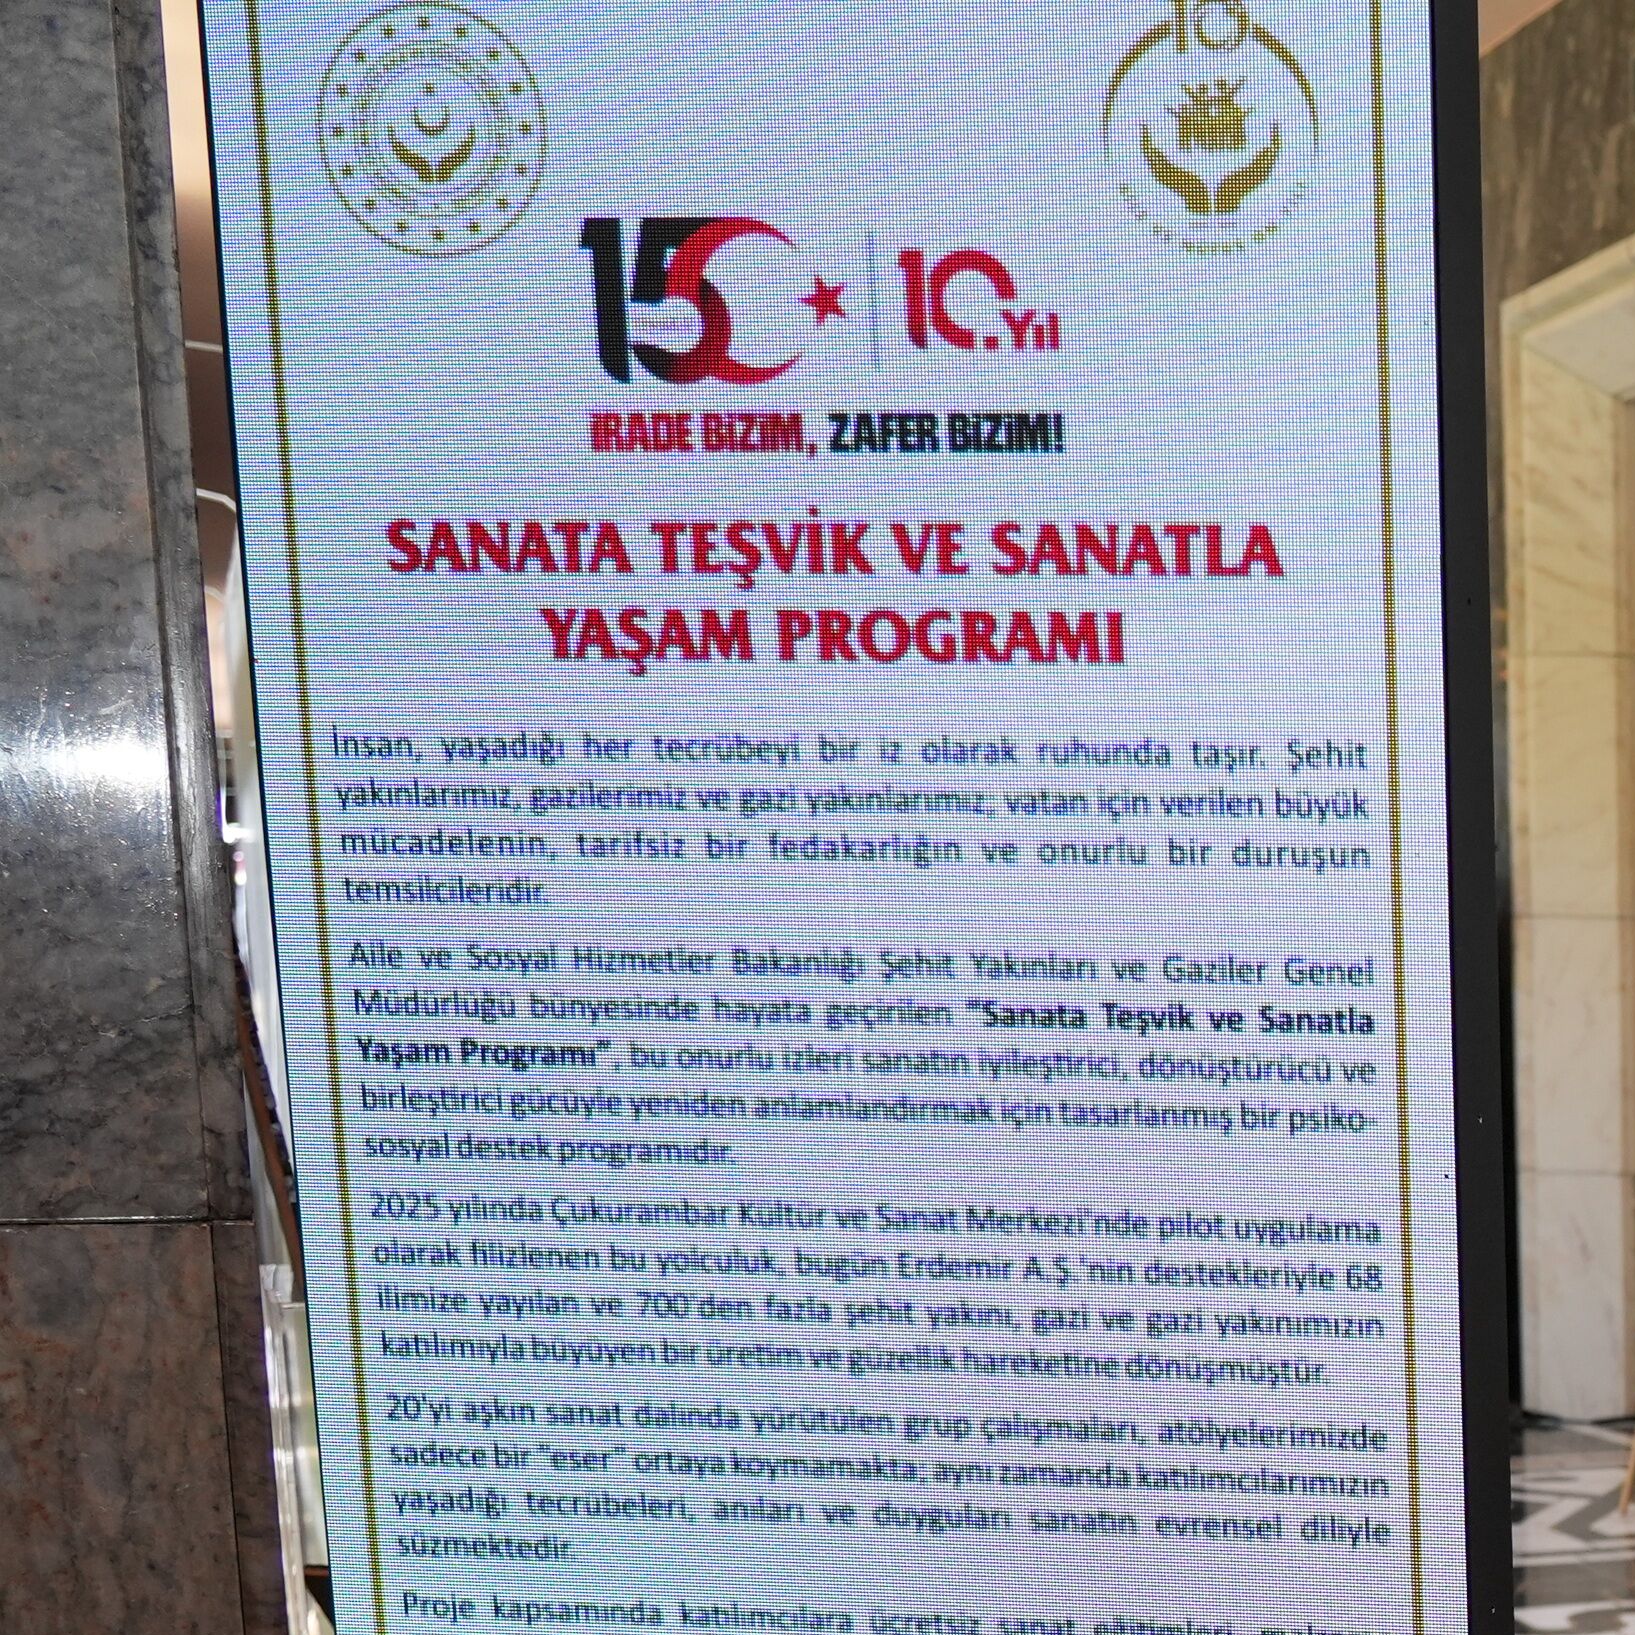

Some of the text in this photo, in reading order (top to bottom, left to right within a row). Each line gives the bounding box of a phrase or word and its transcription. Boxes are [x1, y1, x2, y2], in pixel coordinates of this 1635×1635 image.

[589, 411, 1065, 460] İRADE BİZİM, ZAFER BİZİM!
[387, 504, 1284, 590] SANATA TEŞVİK VE SANATLA
[541, 607, 1126, 675] YAŞAM PROGRAMI
[330, 725, 422, 766] İnsan,
[441, 729, 566, 766] yaşadığı
[581, 730, 634, 761] her
[817, 732, 858, 763] bir
[879, 732, 901, 763] iz
[920, 733, 1017, 764] olarak
[1036, 734, 1172, 765] ruhunda
[1189, 741, 1266, 772] taşır.
[1286, 735, 1366, 772] Şehit
[338, 824, 556, 864] mücadelenin,
[574, 828, 685, 859] tarifsiz
[703, 829, 748, 860] bir
[980, 842, 1018, 863] ve
[1037, 834, 1147, 865] onurlu
[1166, 835, 1211, 866] bir
[1231, 835, 1370, 873] duruşun
[352, 986, 515, 1020] Müdürlüğü
[530, 989, 697, 1027] bünyesinde
[713, 992, 811, 1030] hayata
[1102, 999, 1194, 1036] Teşvik
[1207, 1010, 1245, 1032] ve
[1258, 1001, 1375, 1034] Sanatla
[356, 1034, 452, 1072] Yaşam
[630, 1039, 667, 1071] bu
[676, 1041, 773, 1073] onurlu
[783, 1042, 852, 1074] izleri
[863, 1051, 969, 1076] sanatın
[1137, 1049, 1332, 1087] dönüştürücü
[1342, 1063, 1375, 1084] ve
[370, 1189, 441, 1221] 2025
[448, 1192, 543, 1228] yılında
[549, 1193, 728, 1230] Çukurambar
[834, 1210, 868, 1232] ve
[874, 1201, 957, 1234] Sanat
[1156, 1208, 1225, 1245] pilot
[1232, 1211, 1382, 1248] uygulama
